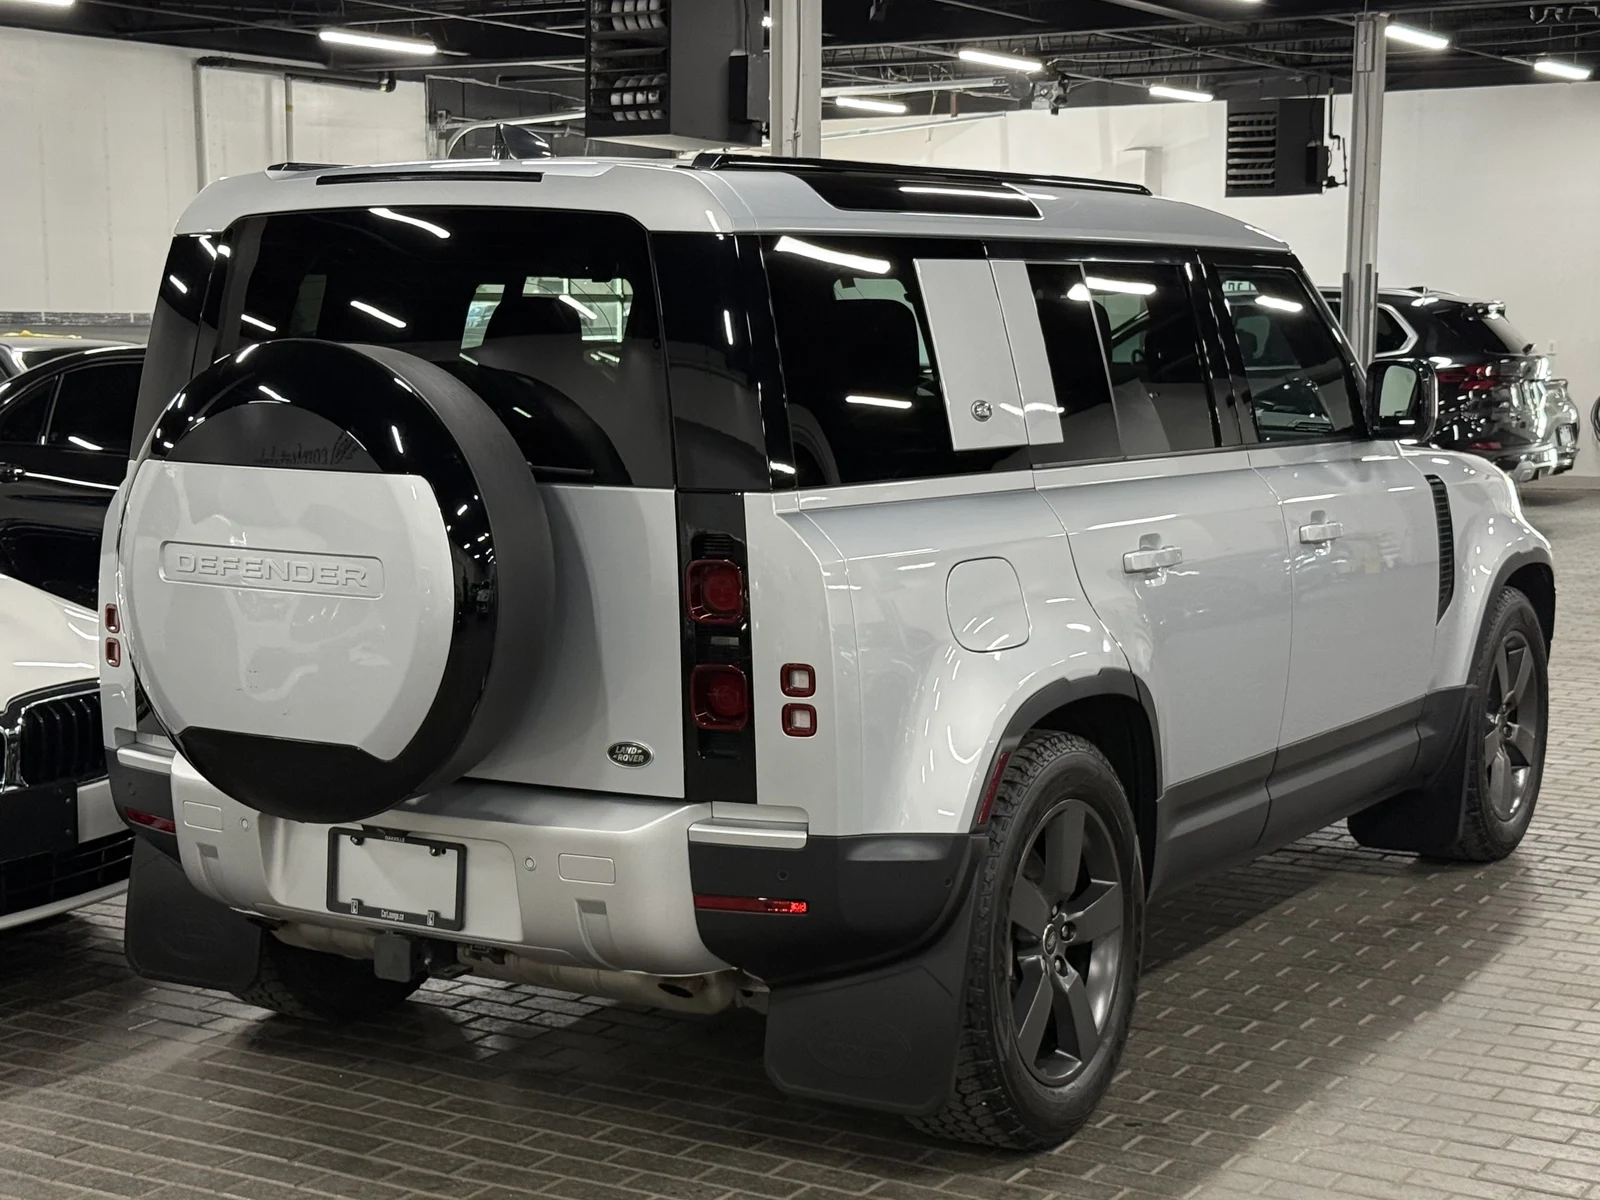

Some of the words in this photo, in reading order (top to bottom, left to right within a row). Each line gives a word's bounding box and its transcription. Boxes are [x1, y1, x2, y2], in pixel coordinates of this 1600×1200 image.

[175, 552, 368, 588] DEFENDER
[615, 746, 637, 754] LAND
[617, 754, 644, 762] ROVER
